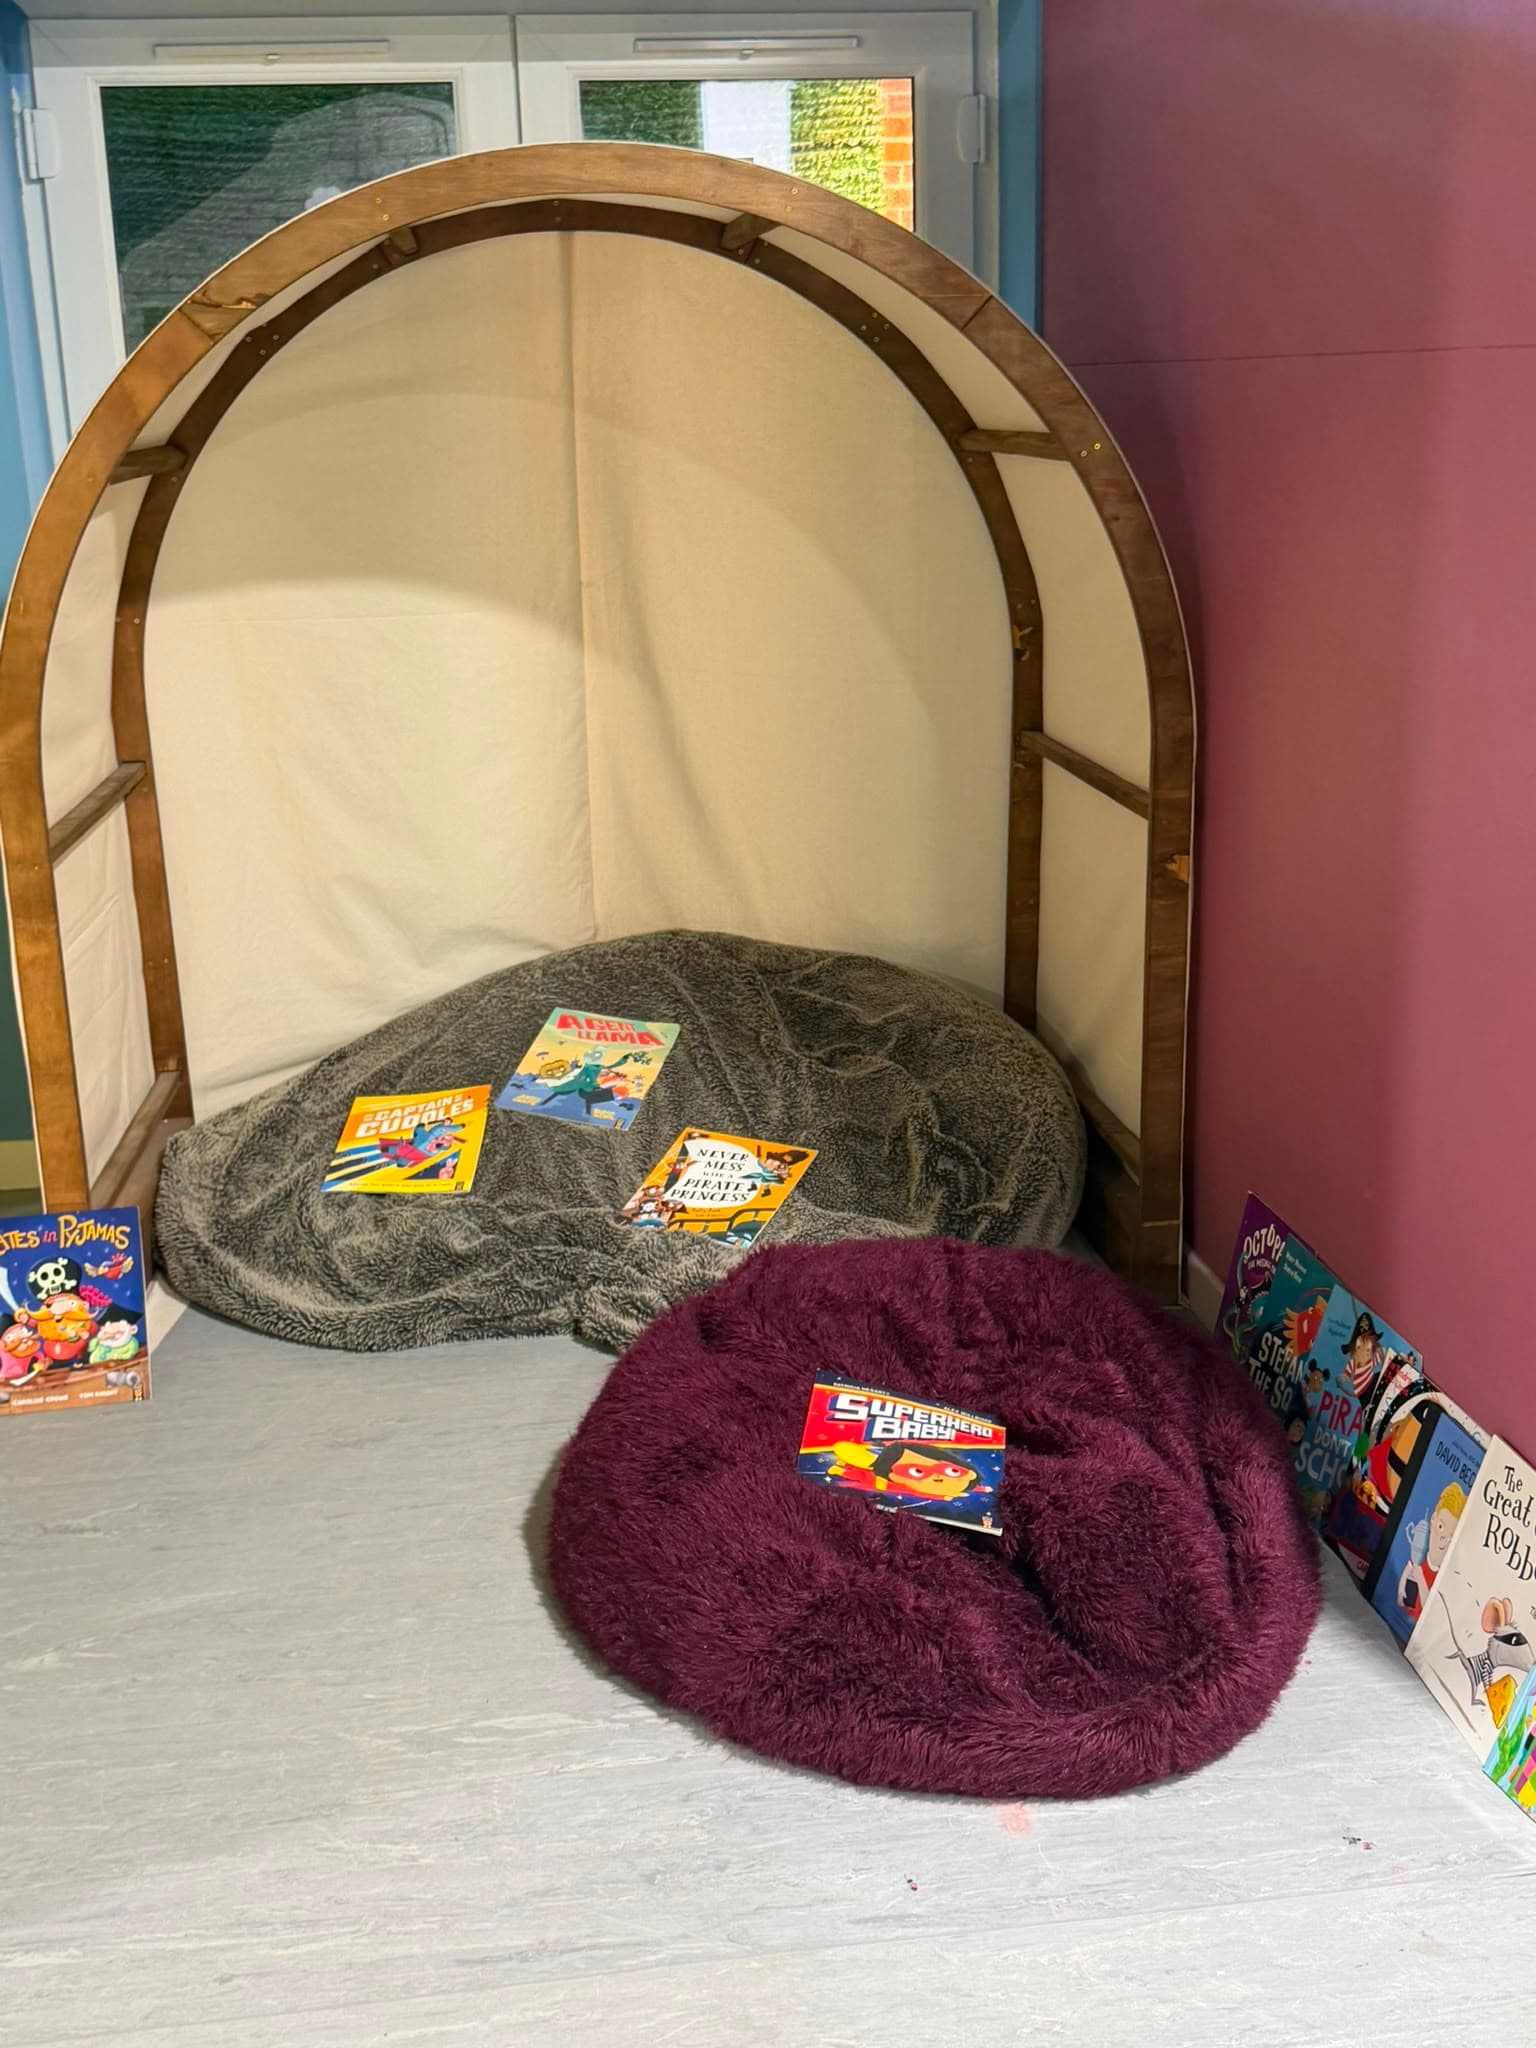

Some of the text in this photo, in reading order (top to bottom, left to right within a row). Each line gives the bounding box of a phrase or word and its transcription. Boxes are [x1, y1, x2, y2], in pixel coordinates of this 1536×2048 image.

[557, 1014, 634, 1031] AGENT
[576, 1031, 664, 1046] LLAMA
[355, 1098, 474, 1138] CUDDLES
[374, 1096, 453, 1121] CAPTAIN
[697, 1148, 749, 1161] NEVER
[704, 1160, 745, 1172] MESS
[670, 1189, 750, 1202] PRINCESS
[682, 1178, 745, 1192] PIRATE
[42, 1230, 57, 1243] in
[1248, 1356, 1272, 1393] THE
[834, 1393, 993, 1438] SUPERHERO
[1436, 1441, 1460, 1473] DAVID
[1504, 1465, 1523, 1493] The
[1483, 1479, 1535, 1528] Great
[1482, 1513, 1536, 1582] Robb
